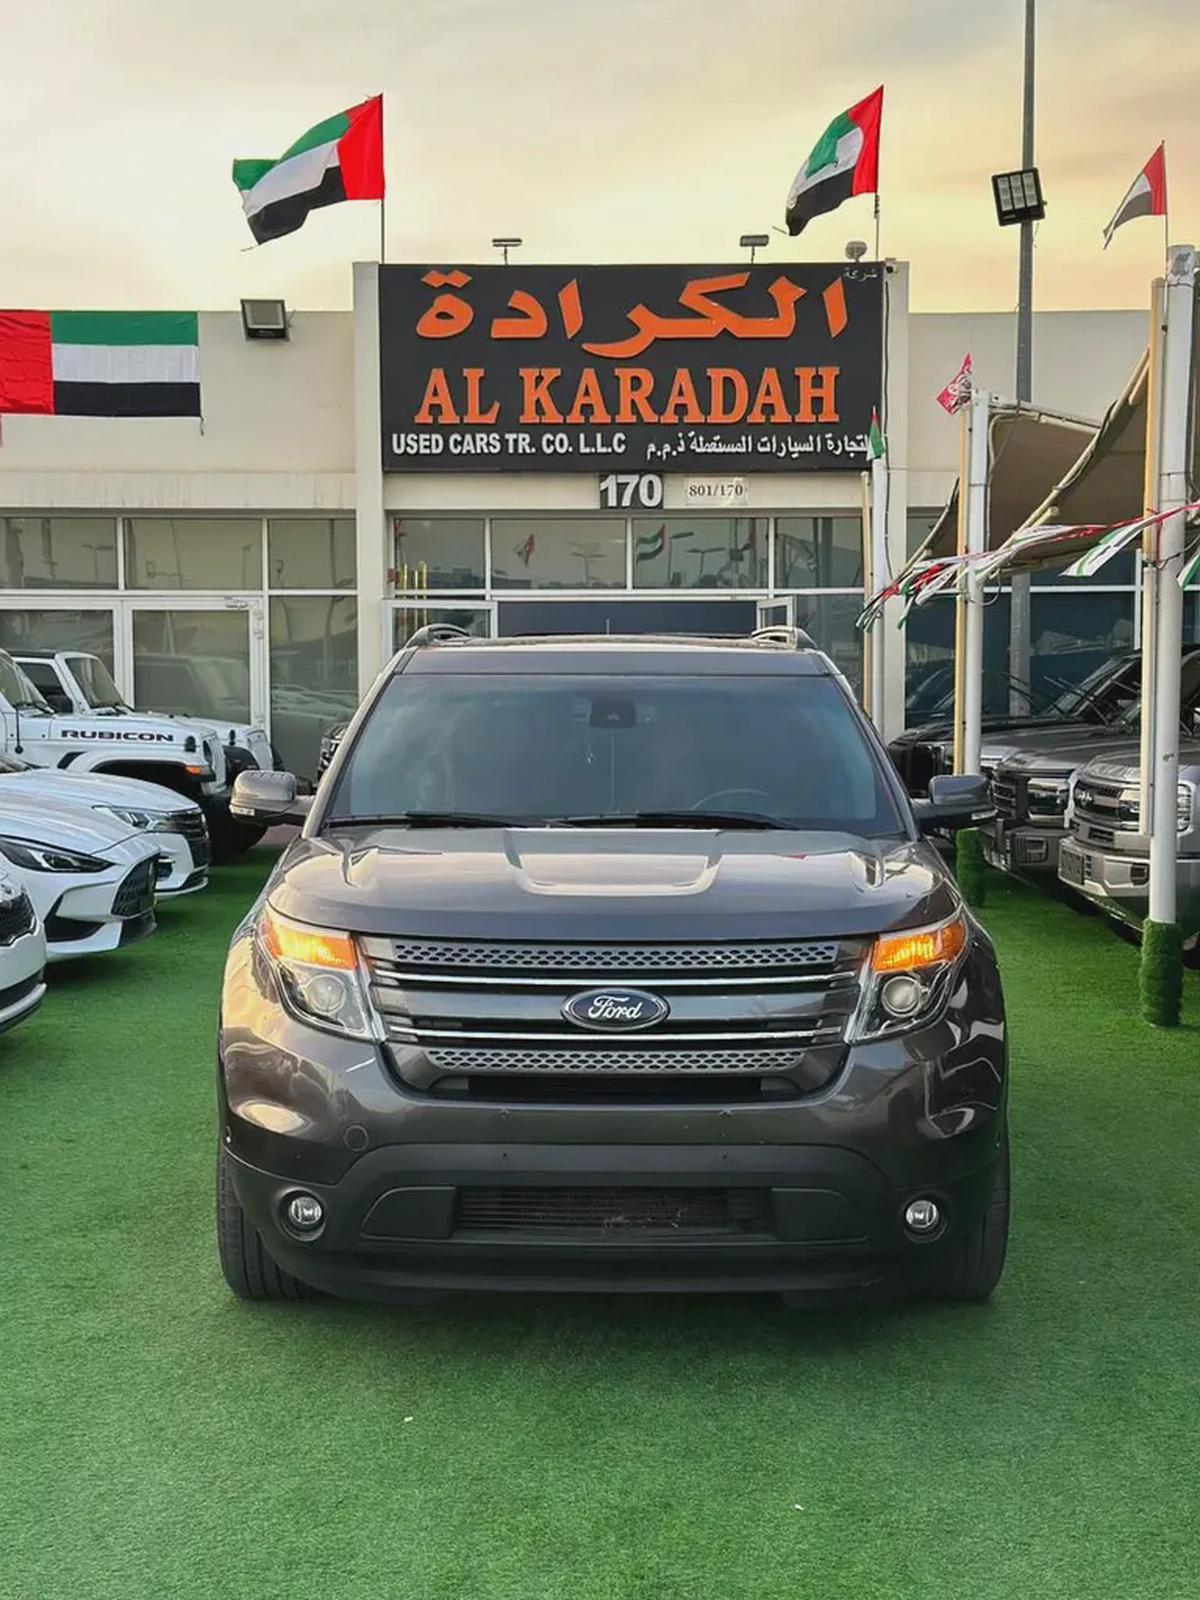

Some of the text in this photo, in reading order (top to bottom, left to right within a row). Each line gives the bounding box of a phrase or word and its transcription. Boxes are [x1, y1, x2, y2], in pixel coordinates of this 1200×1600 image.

[416, 270, 847, 358] الكرادة
[414, 366, 840, 424] AL KARADAH
[392, 433, 626, 454] USED CARS TR. CO. L.L.C
[757, 434, 821, 458] السيارات
[599, 474, 663, 507] 170
[688, 485, 744, 498] 801/170
[61, 730, 174, 742] RUBICON
[588, 995, 643, 1019] Ford
